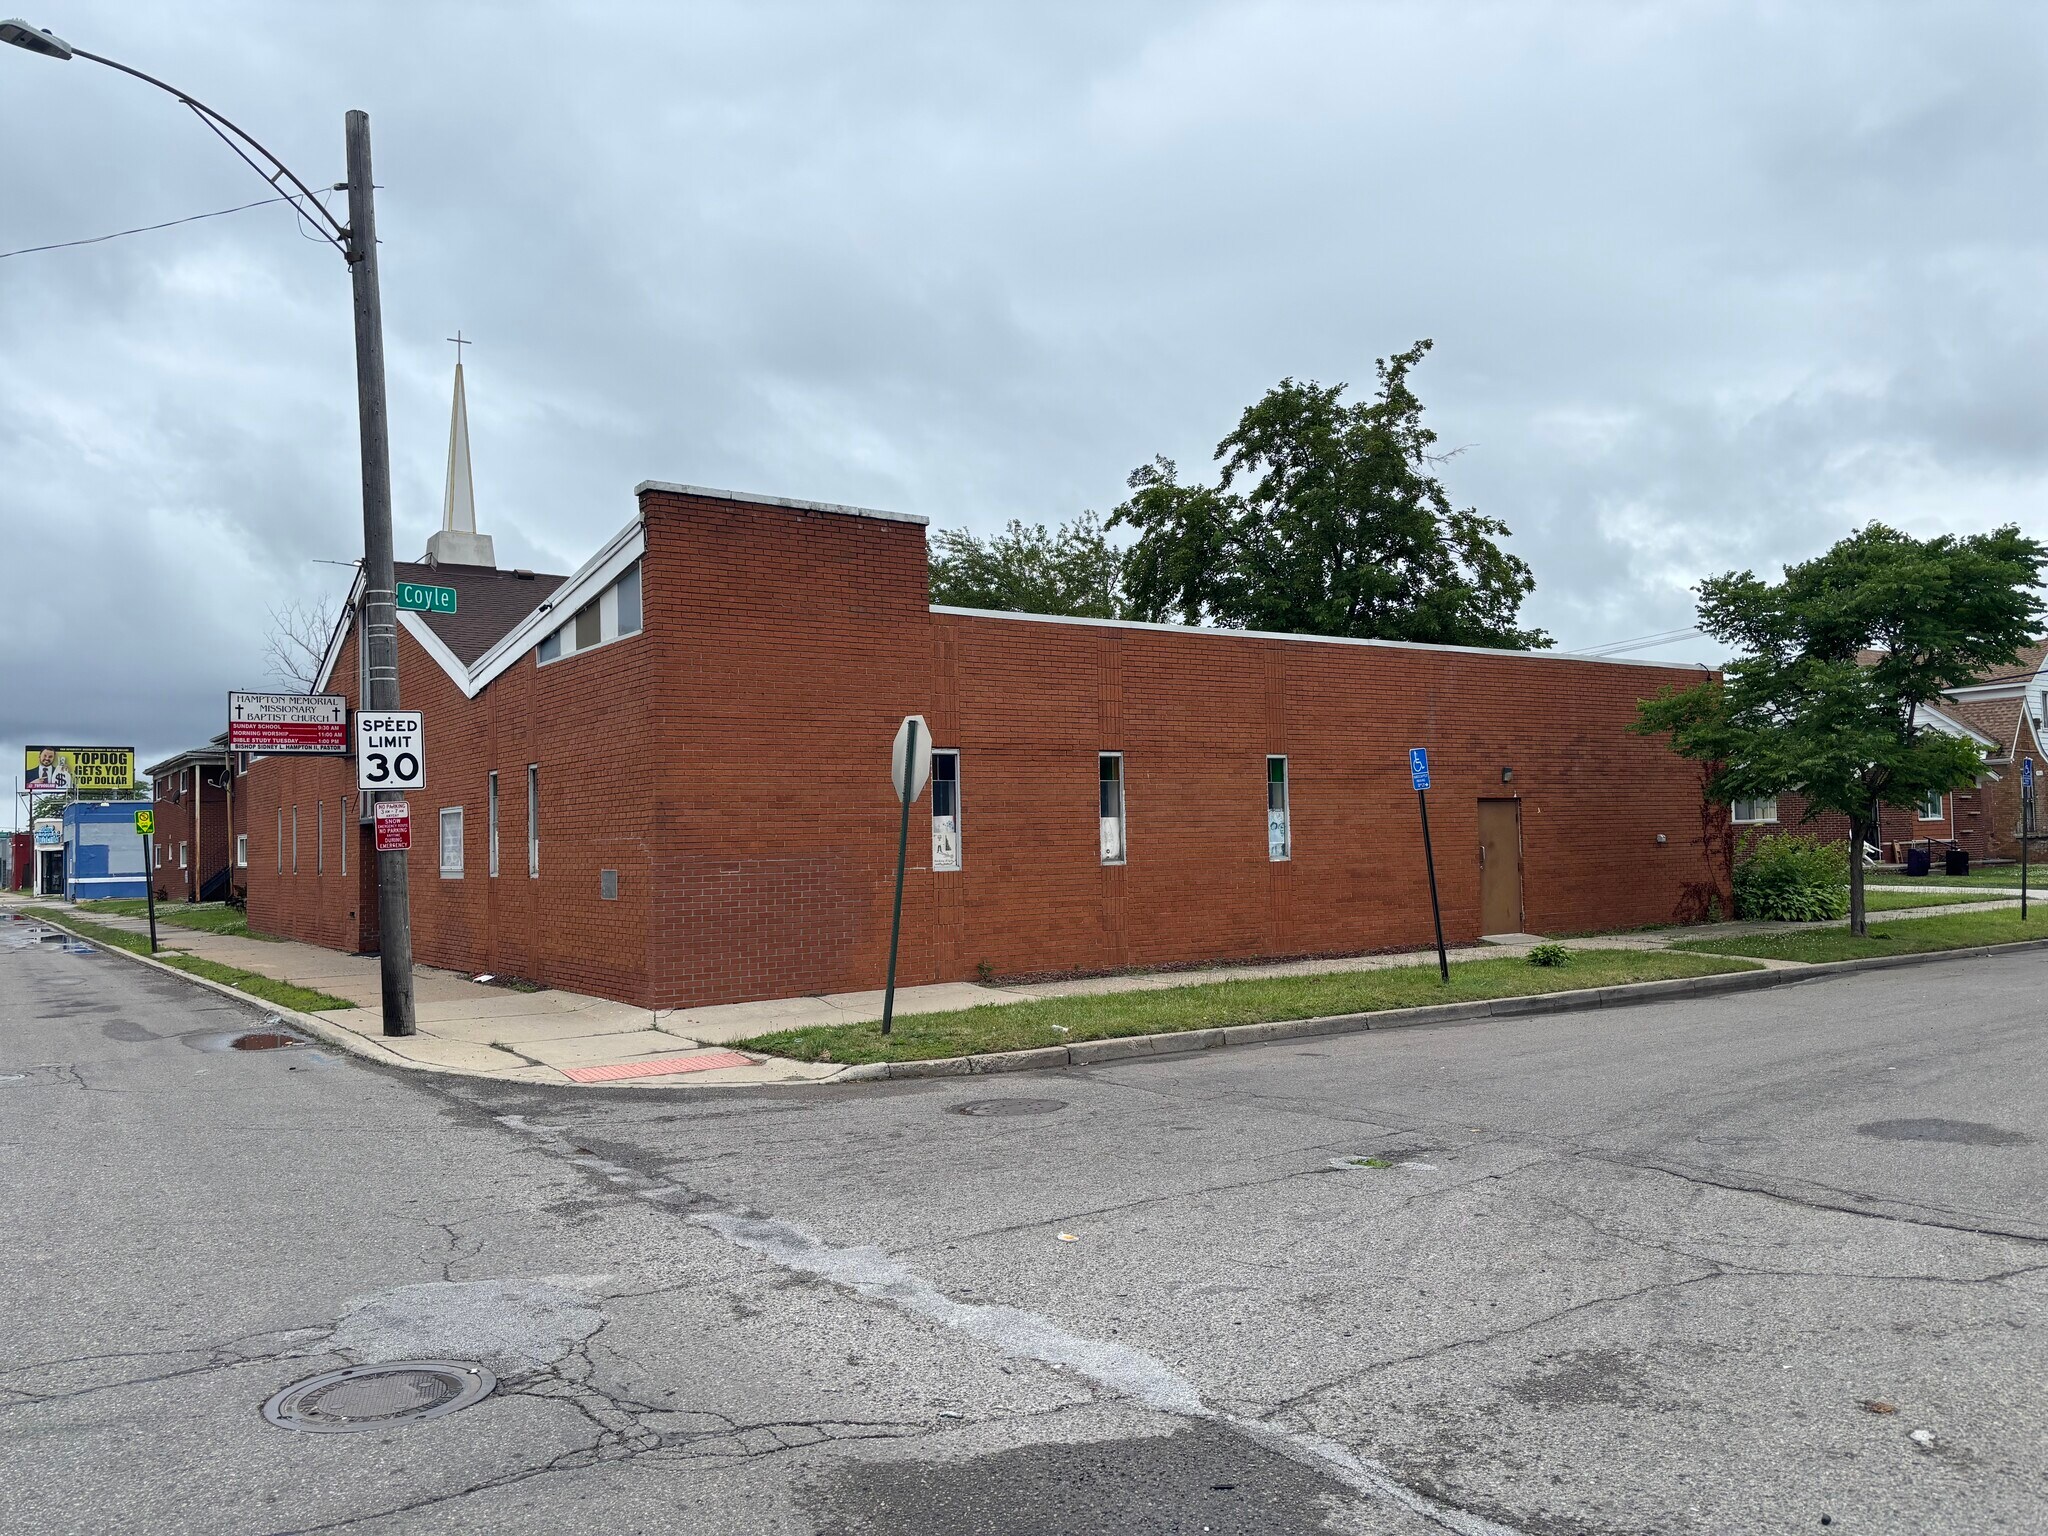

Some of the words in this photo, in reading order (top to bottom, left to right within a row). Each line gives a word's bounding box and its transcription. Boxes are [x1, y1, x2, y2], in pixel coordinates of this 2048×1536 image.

[404, 586, 449, 609] Coyle
[237, 695, 285, 704] HAMPTON
[289, 697, 338, 705] MEMORIAL
[260, 705, 317, 714] MISSIONARY
[363, 720, 417, 732] SPEED
[369, 736, 412, 748] LIMIT
[73, 752, 127, 764] TOPDOG
[75, 766, 102, 776] GETS
[105, 766, 127, 776] YOU
[366, 753, 419, 782] 30
[95, 776, 127, 784] DOLLAR
